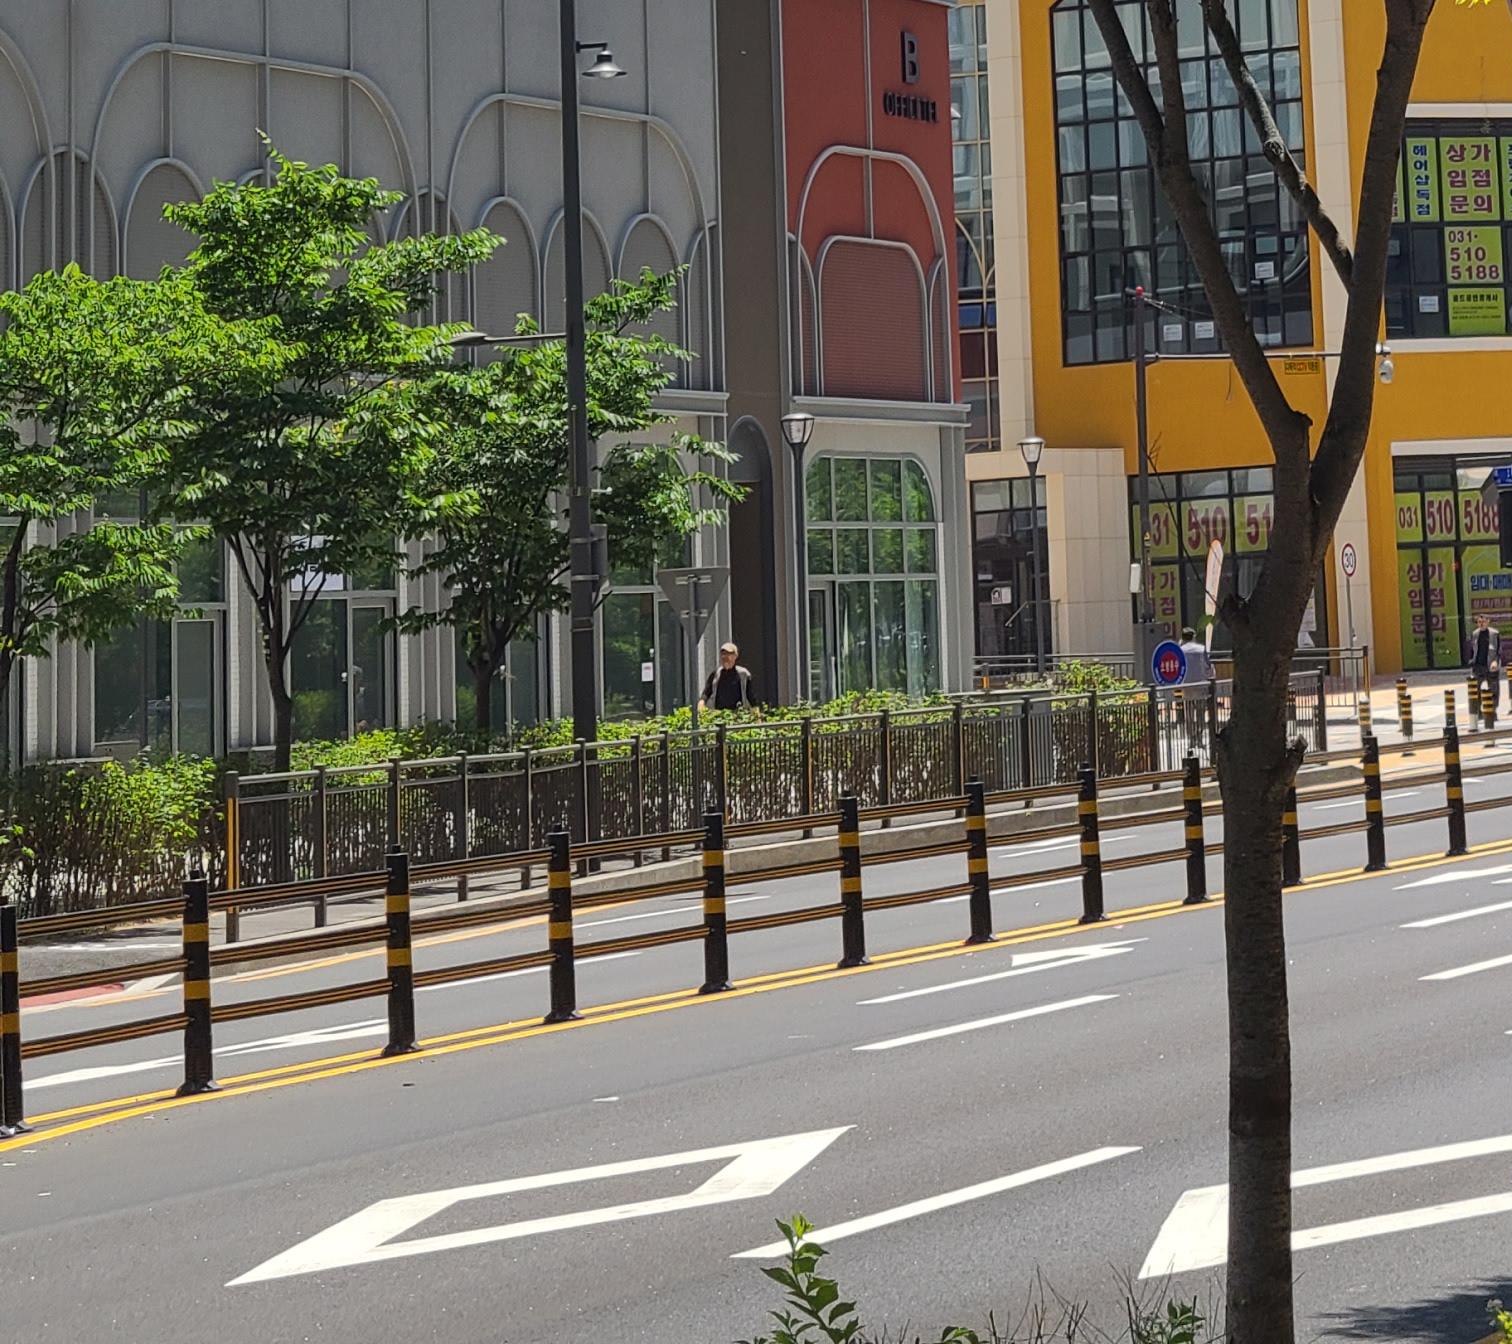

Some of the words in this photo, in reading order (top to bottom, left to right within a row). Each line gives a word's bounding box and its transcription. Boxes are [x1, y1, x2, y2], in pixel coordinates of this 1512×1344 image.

[901, 31, 919, 84] B
[1446, 144, 1491, 162] 상가
[1447, 169, 1491, 188] 입점
[1450, 194, 1493, 213] 문의
[1450, 247, 1486, 262] 510
[1451, 265, 1500, 280] 5188
[1399, 507, 1418, 528] 031
[1427, 499, 1454, 535] 510
[1152, 512, 1170, 546] 31
[1188, 506, 1227, 550] 510
[1344, 553, 1354, 567] 30
[1407, 563, 1444, 583] 상가
